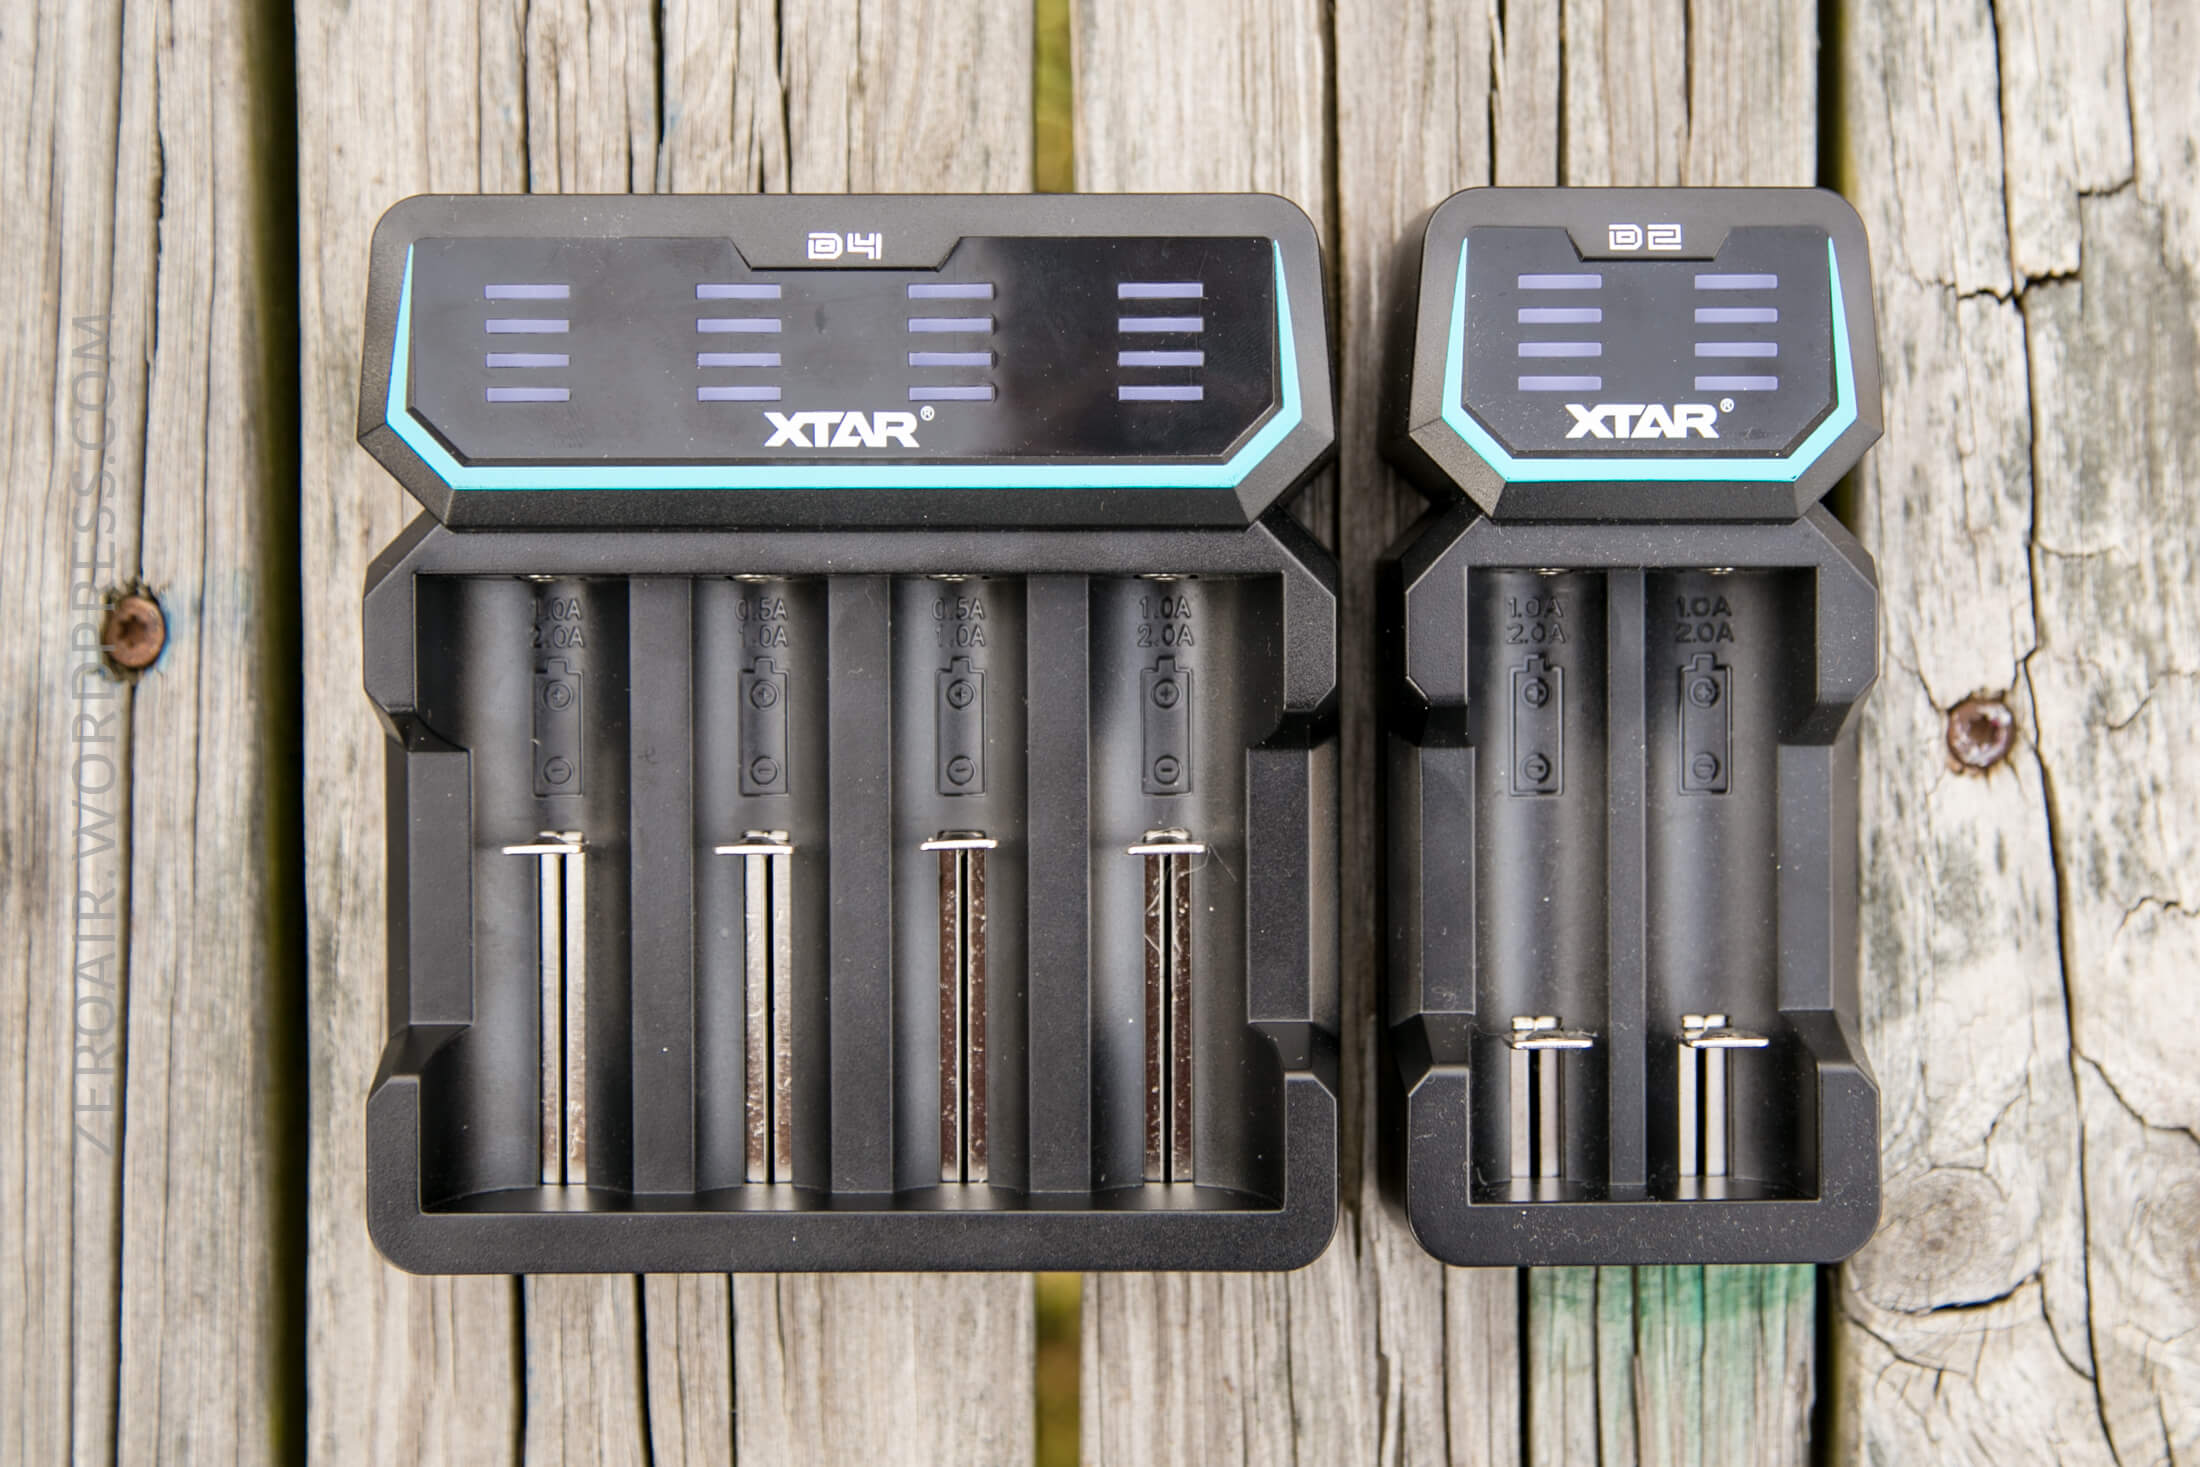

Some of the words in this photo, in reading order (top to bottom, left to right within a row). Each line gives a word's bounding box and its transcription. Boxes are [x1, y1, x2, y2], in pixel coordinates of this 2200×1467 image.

[807, 231, 883, 261] D4
[1608, 223, 1683, 251] D2
[735, 597, 788, 621] 0.5A
[930, 597, 986, 620] 0.5A
[1138, 596, 1192, 619] 1.0A
[1508, 596, 1564, 618] 1.0A
[1676, 595, 1733, 618] 1.0A
[935, 624, 986, 648] 1.0A
[1137, 623, 1195, 647] 2.0A
[1507, 622, 1567, 645] 2.0A
[1674, 621, 1735, 644] 2.0A
